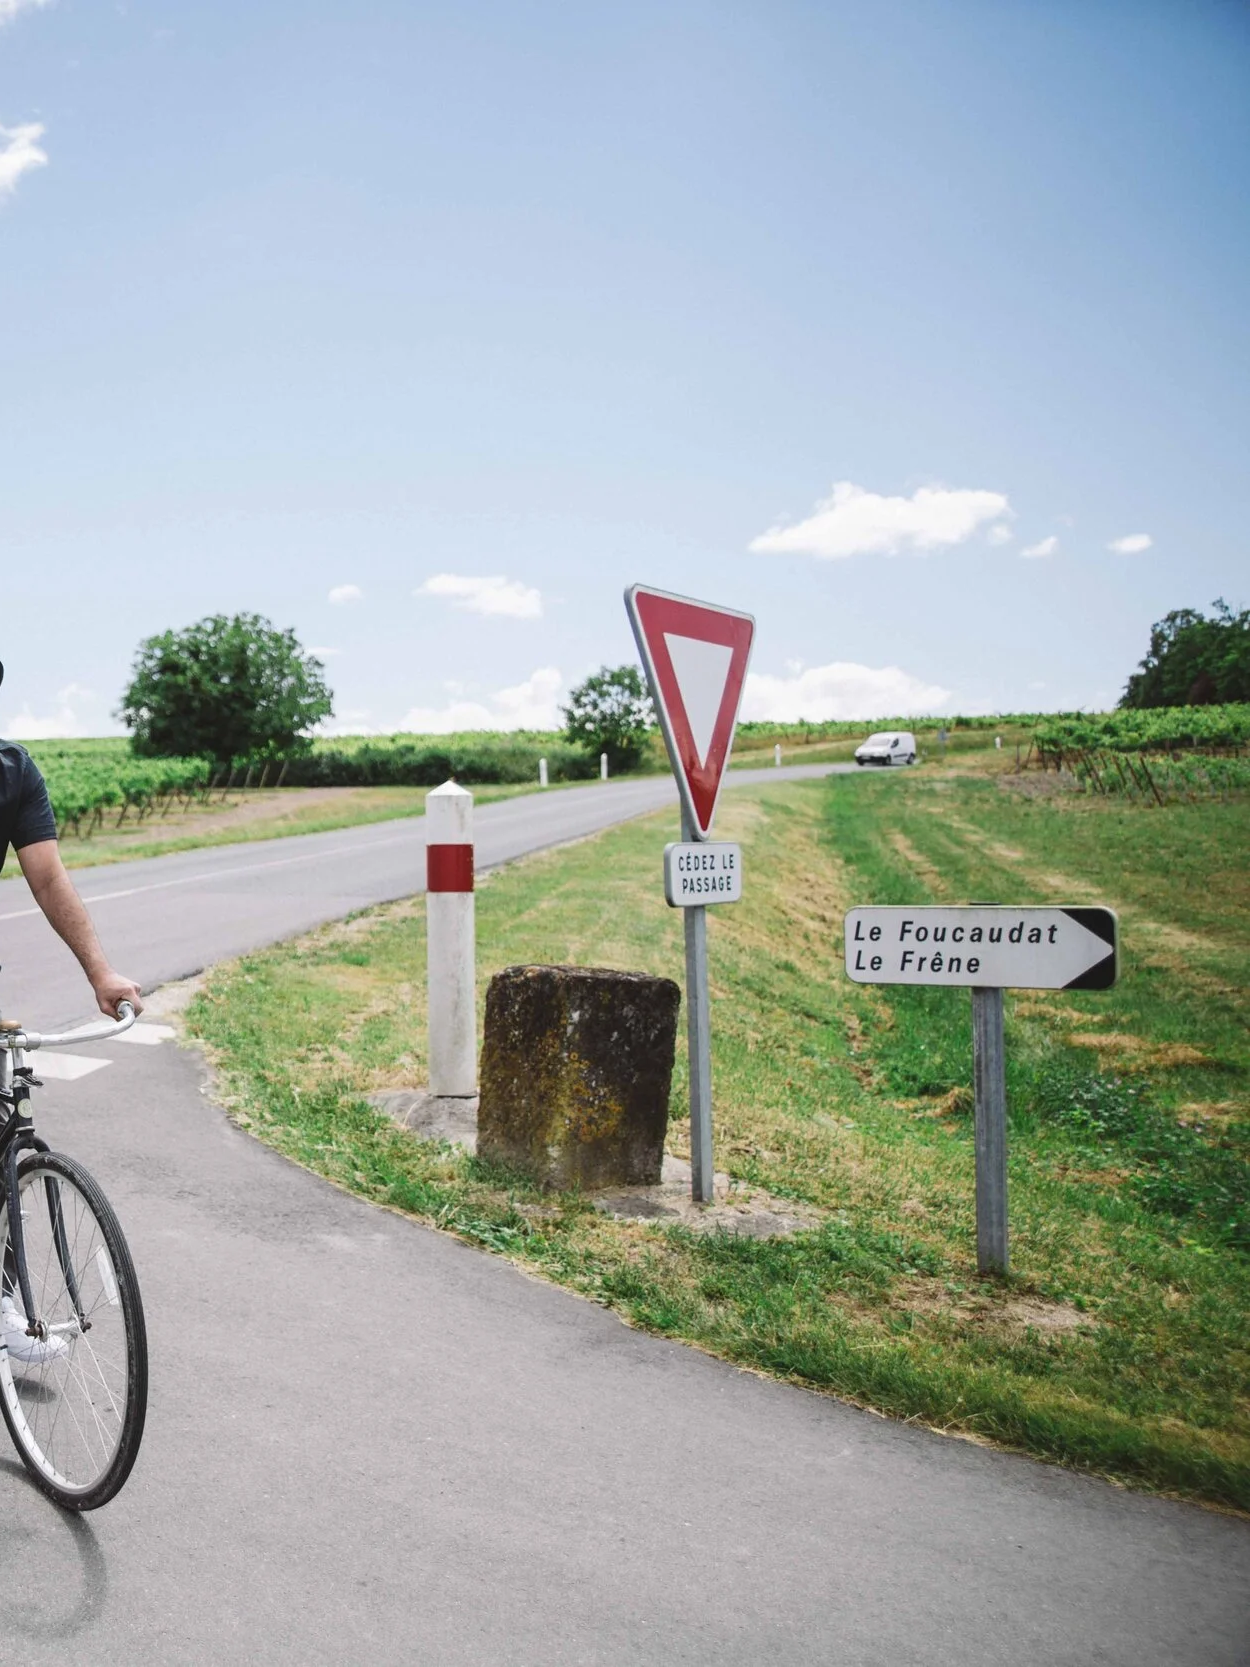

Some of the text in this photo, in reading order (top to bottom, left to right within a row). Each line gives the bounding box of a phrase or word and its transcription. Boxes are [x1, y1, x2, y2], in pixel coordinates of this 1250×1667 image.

[678, 852, 734, 871] CÉDEZ LE
[682, 876, 732, 894] PASSAGE
[854, 921, 1058, 944] Le Foucaudat
[855, 950, 980, 973] Le Frêne
